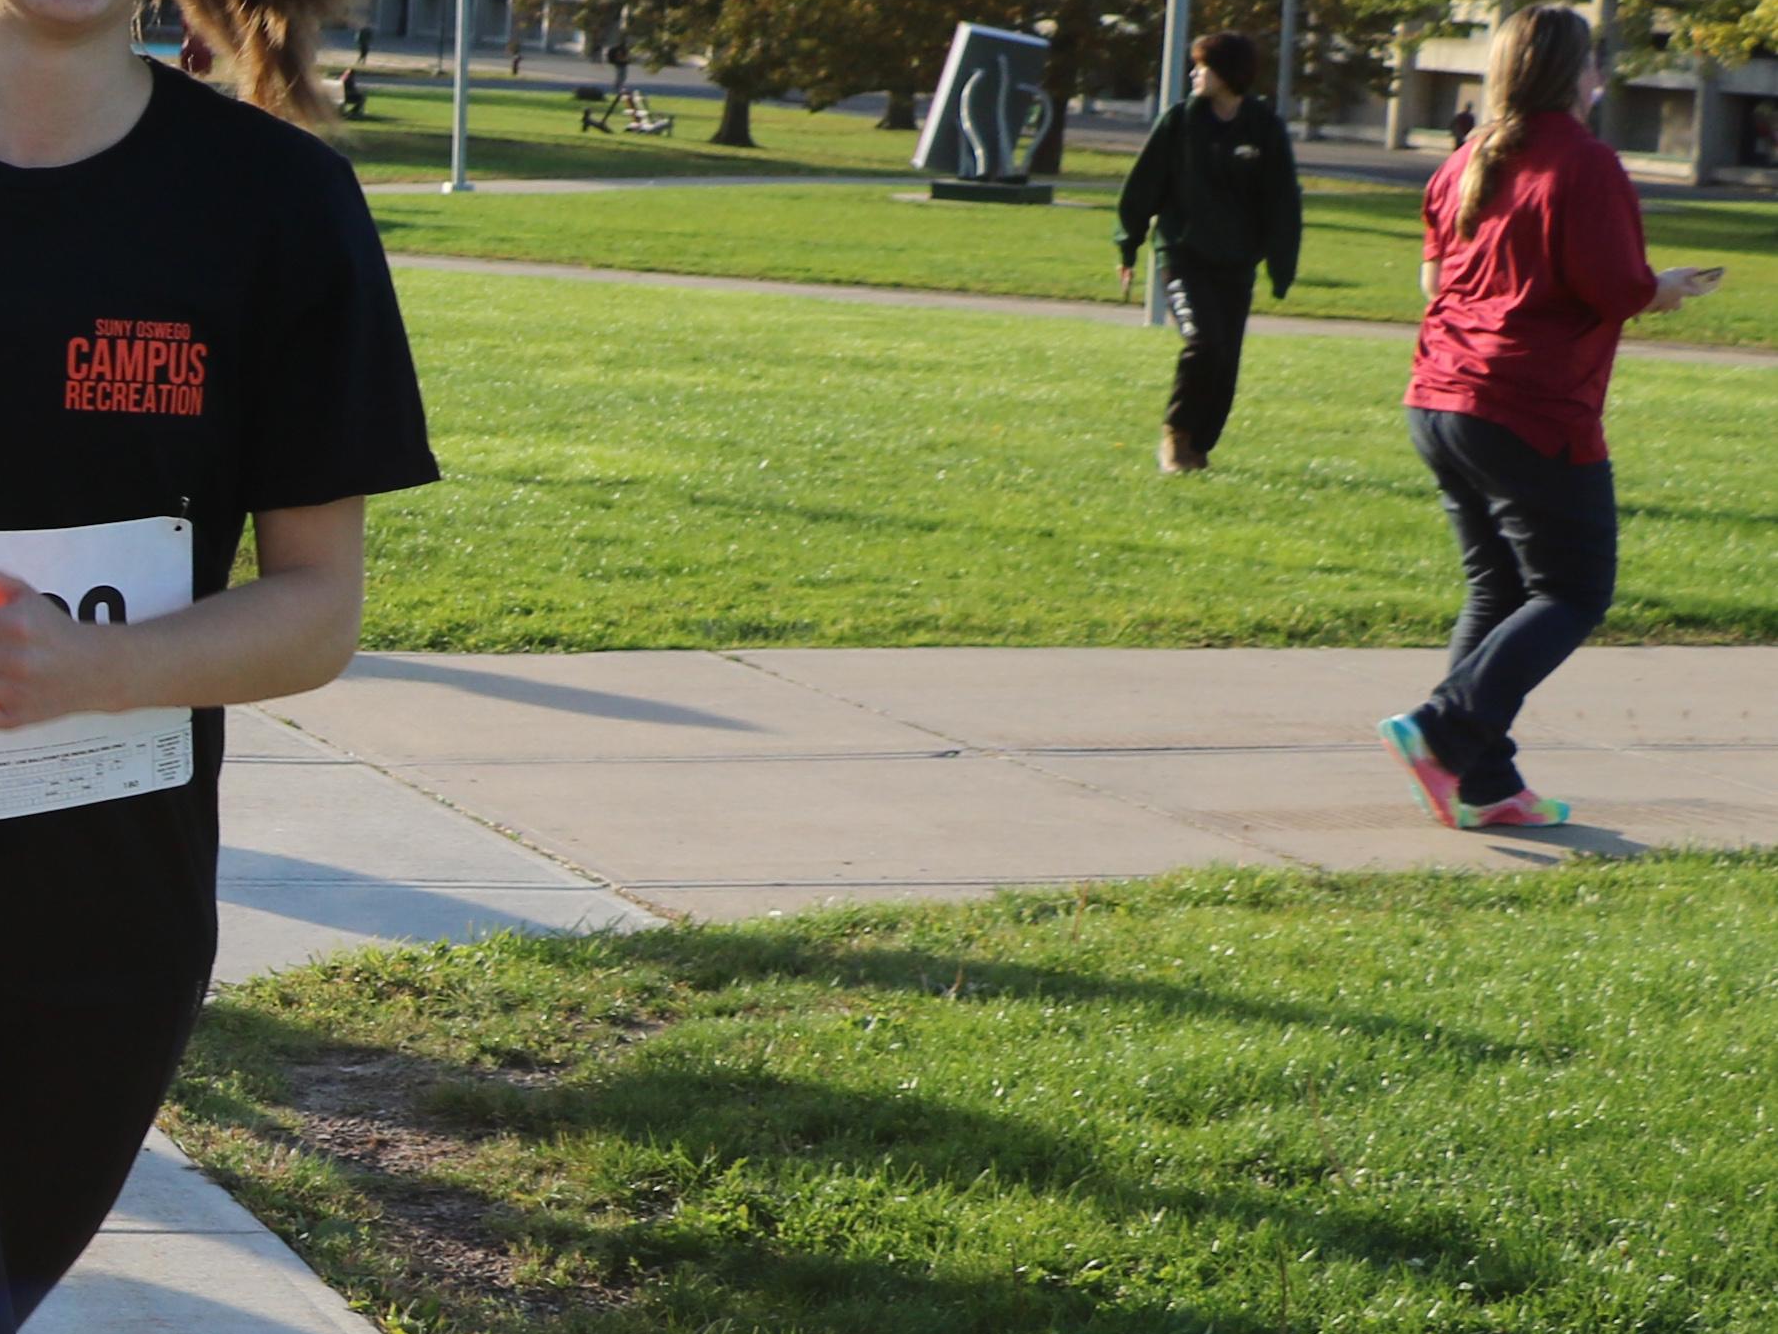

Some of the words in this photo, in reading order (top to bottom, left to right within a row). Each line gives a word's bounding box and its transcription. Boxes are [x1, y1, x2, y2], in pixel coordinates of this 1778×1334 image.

[95, 318, 133, 337] SUNY
[136, 320, 192, 340] OSWEGO
[67, 336, 207, 385] CAMPUS
[65, 380, 204, 416] RECREATION
